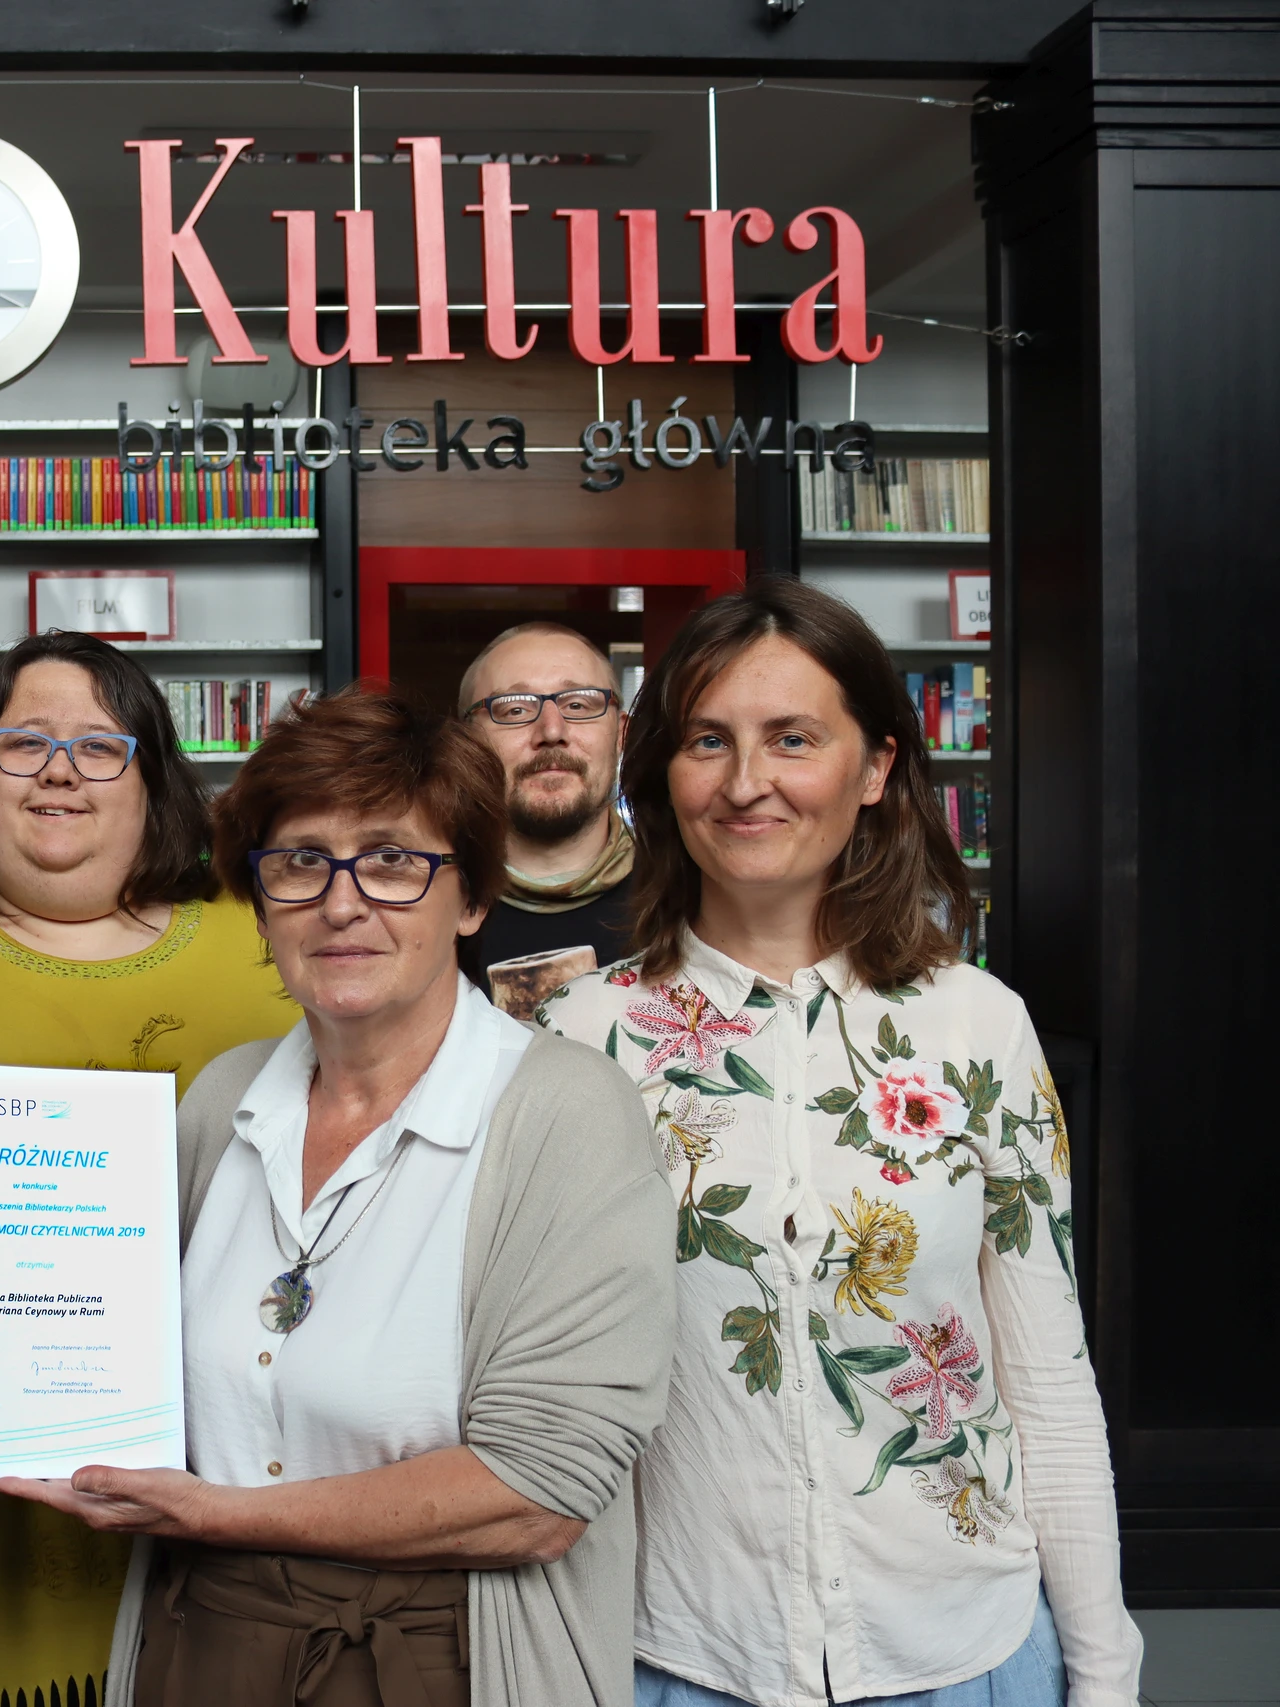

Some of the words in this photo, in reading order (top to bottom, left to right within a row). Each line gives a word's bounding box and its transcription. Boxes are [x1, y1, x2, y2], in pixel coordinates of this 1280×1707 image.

[124, 137, 883, 367] Kultura
[118, 399, 530, 474] biblioteka
[580, 396, 876, 492] główna
[12, 1182, 20, 1190] w
[22, 1182, 58, 1191] konkursie
[24, 1202, 74, 1213] Bibliotekarzy
[75, 1204, 107, 1213] Polskich
[31, 1225, 115, 1237] CZYTELNICTWA
[117, 1226, 146, 1238] 2019
[16, 1261, 55, 1270] otrzymuje
[7, 1293, 55, 1303] Biblioteka
[57, 1294, 103, 1303] Publiczna
[25, 1306, 67, 1318] Ceynowy
[69, 1308, 78, 1316] w
[79, 1307, 105, 1317] Rumi
